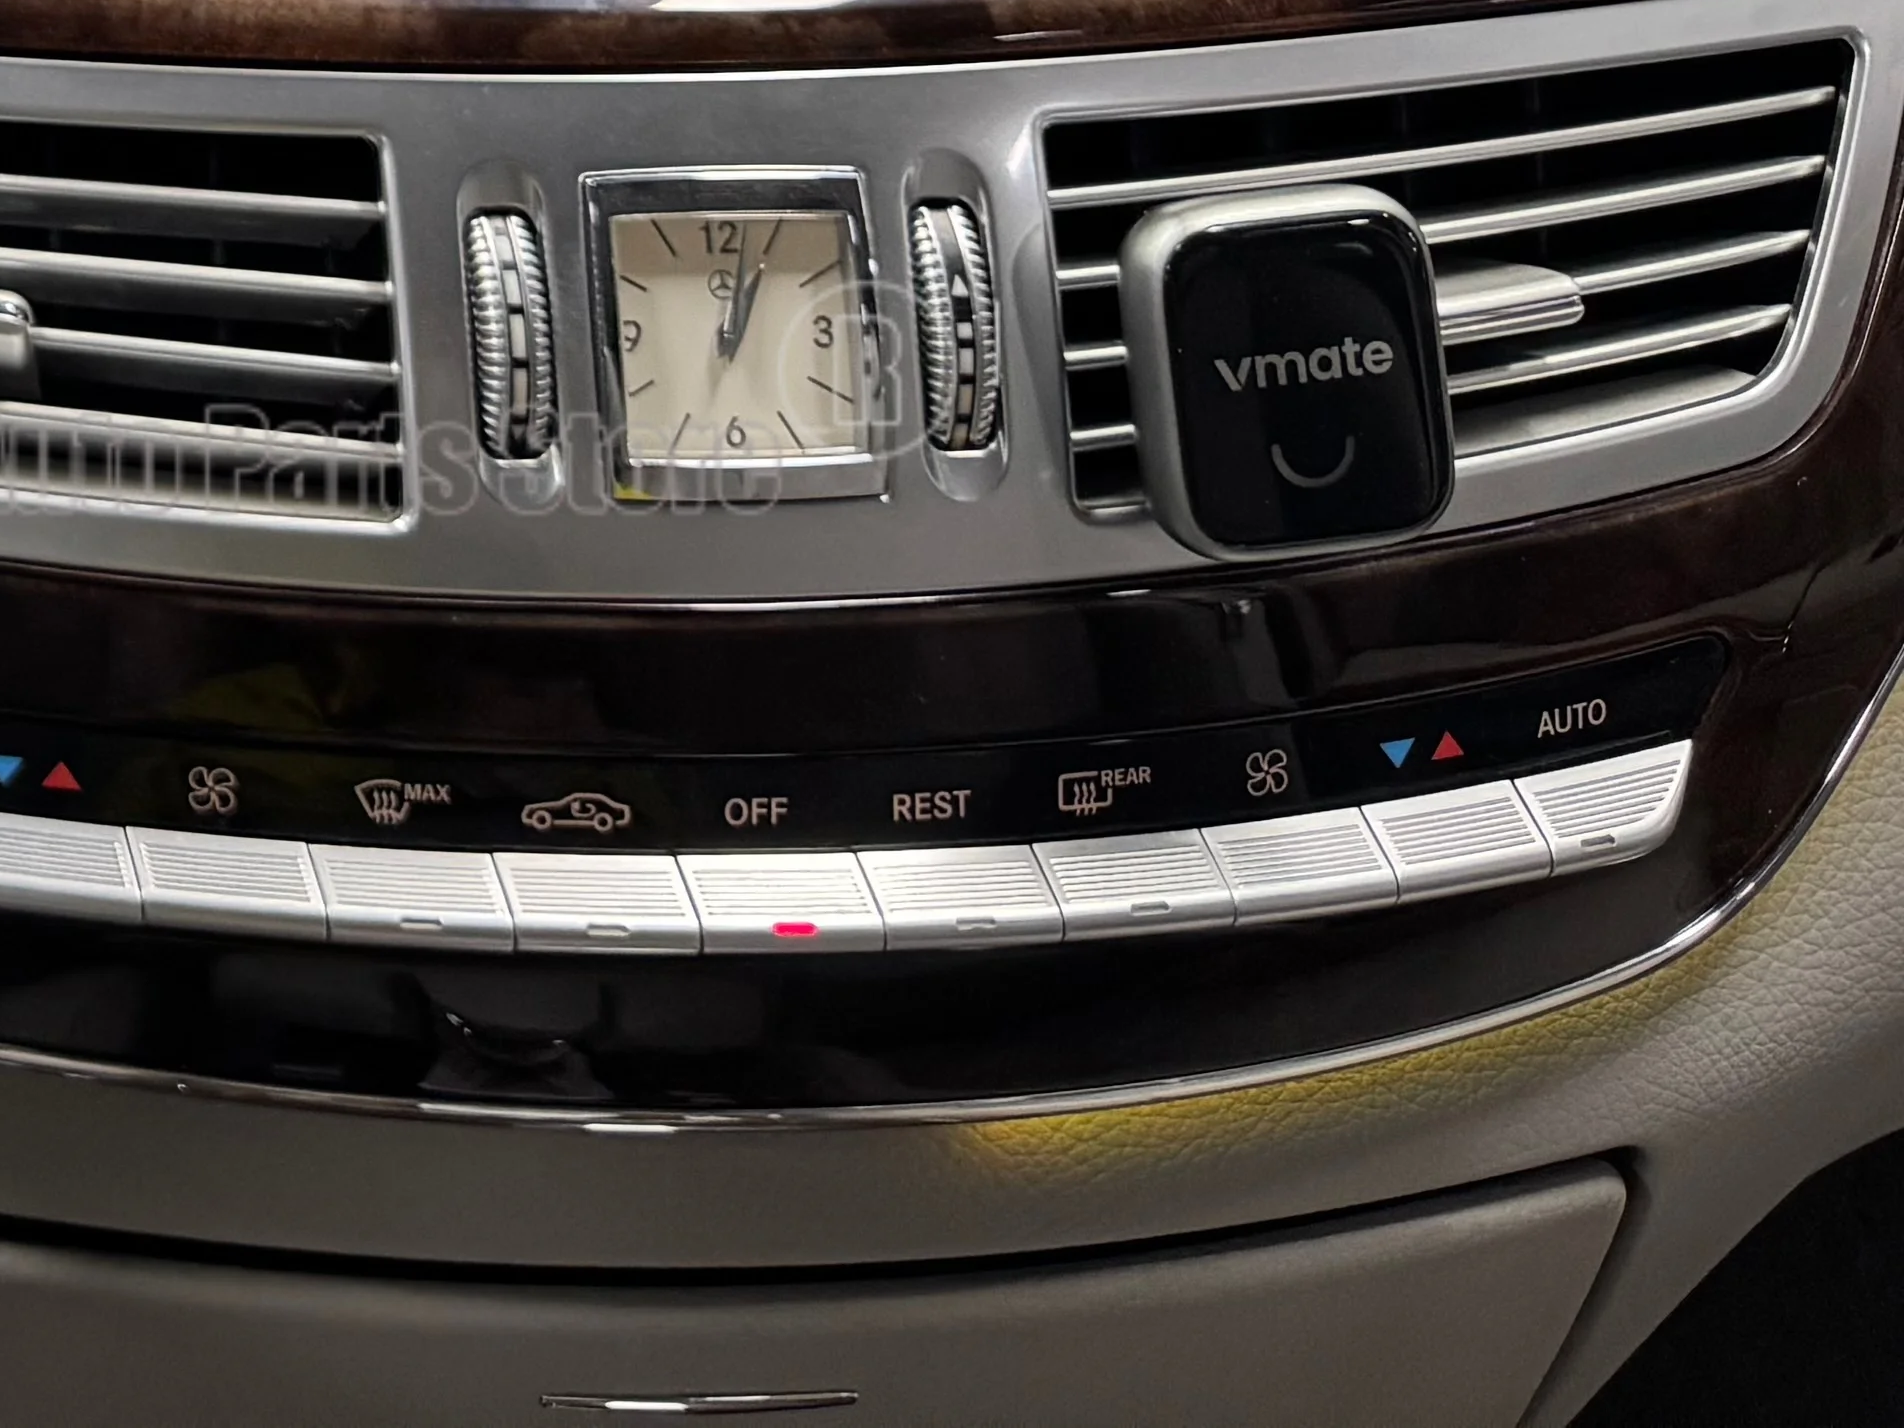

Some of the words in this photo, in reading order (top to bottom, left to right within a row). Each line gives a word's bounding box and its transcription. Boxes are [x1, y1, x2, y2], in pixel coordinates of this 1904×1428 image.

[697, 220, 740, 255] 12
[811, 314, 835, 349] 3
[1213, 336, 1394, 392] vmate
[724, 415, 748, 449] 6
[1536, 698, 1608, 740] AUTO
[1100, 764, 1152, 788] REAR
[402, 782, 452, 806] MAX
[892, 789, 972, 823] REST
[724, 795, 789, 828] OFF
